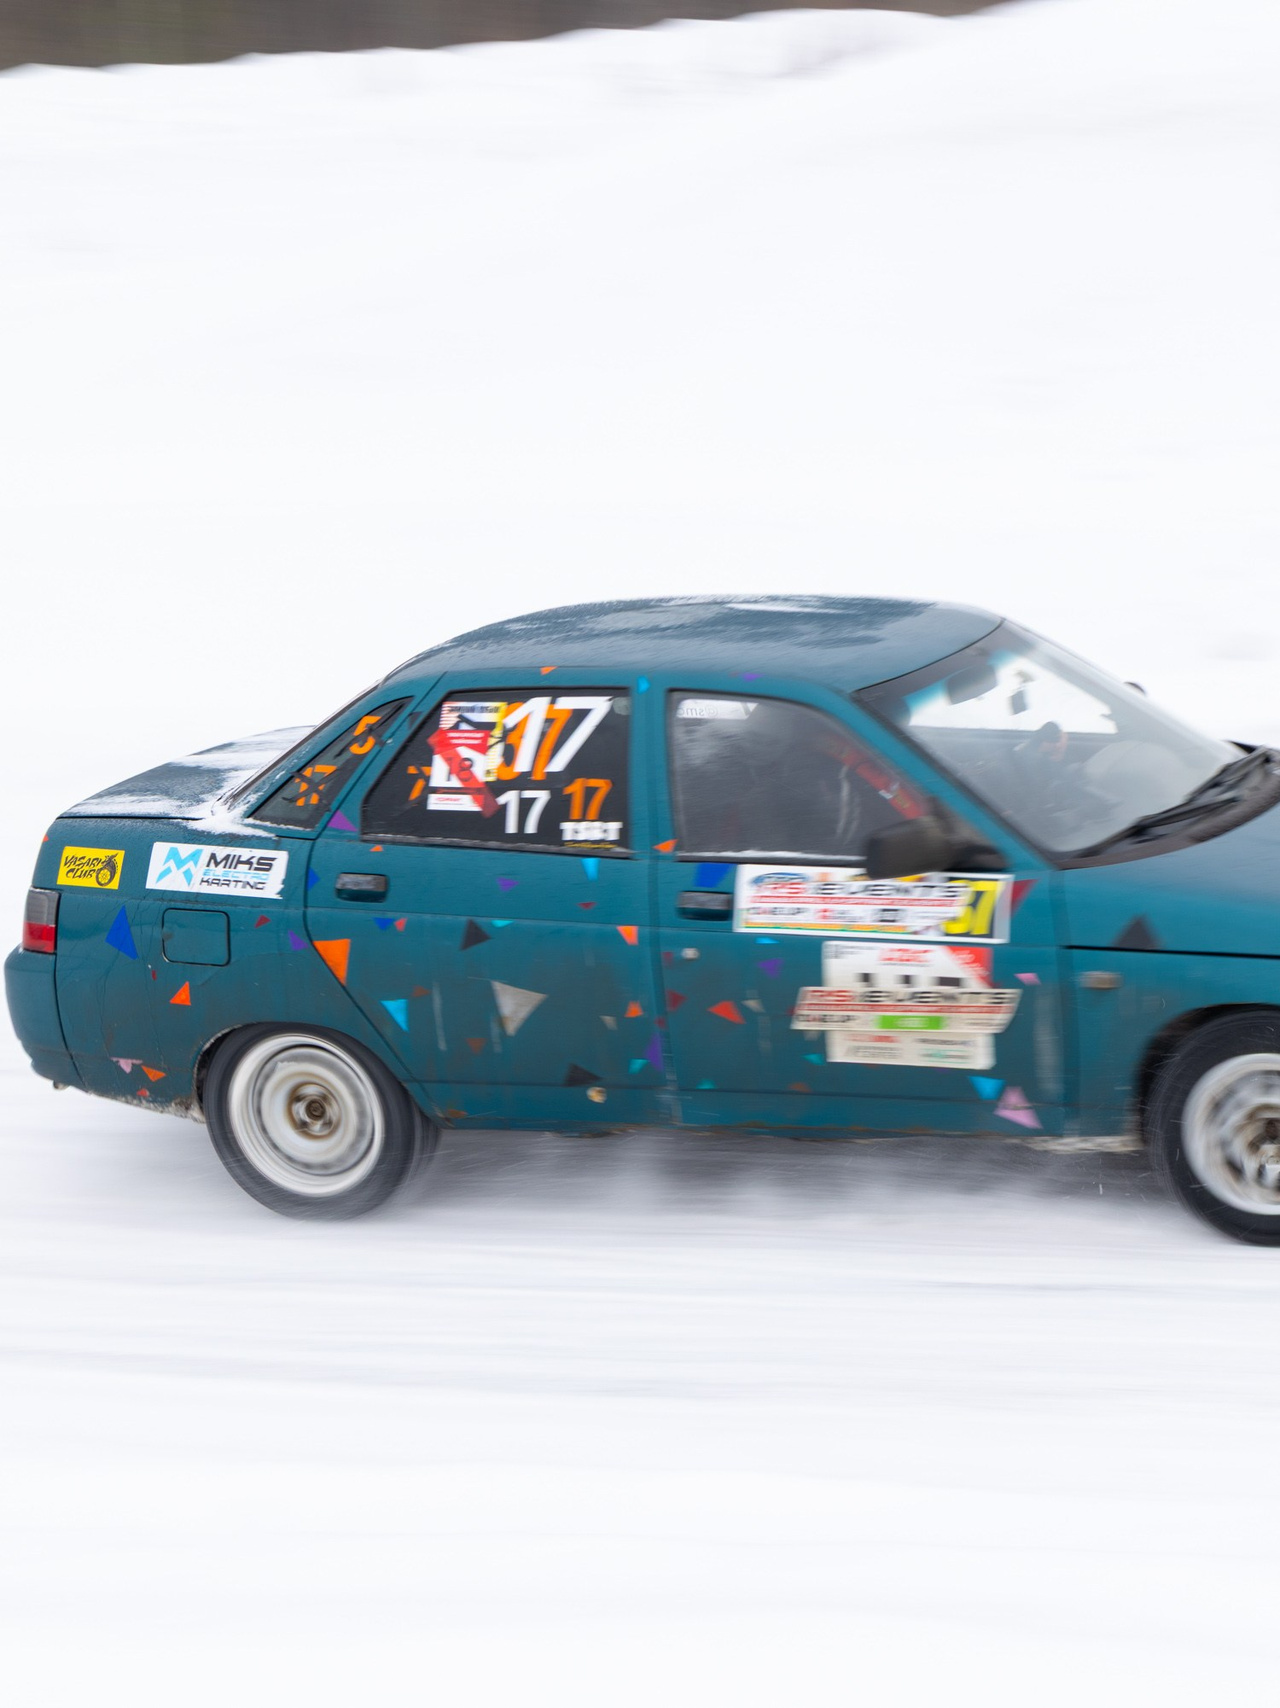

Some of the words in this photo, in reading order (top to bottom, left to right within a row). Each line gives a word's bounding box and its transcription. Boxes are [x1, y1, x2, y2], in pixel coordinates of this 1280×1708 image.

[502, 696, 613, 772] 17
[495, 790, 552, 834] 17
[562, 777, 613, 821] 17
[66, 868, 96, 879] CLUB
[206, 852, 278, 872] MIKS
[200, 878, 267, 891] KARTING
